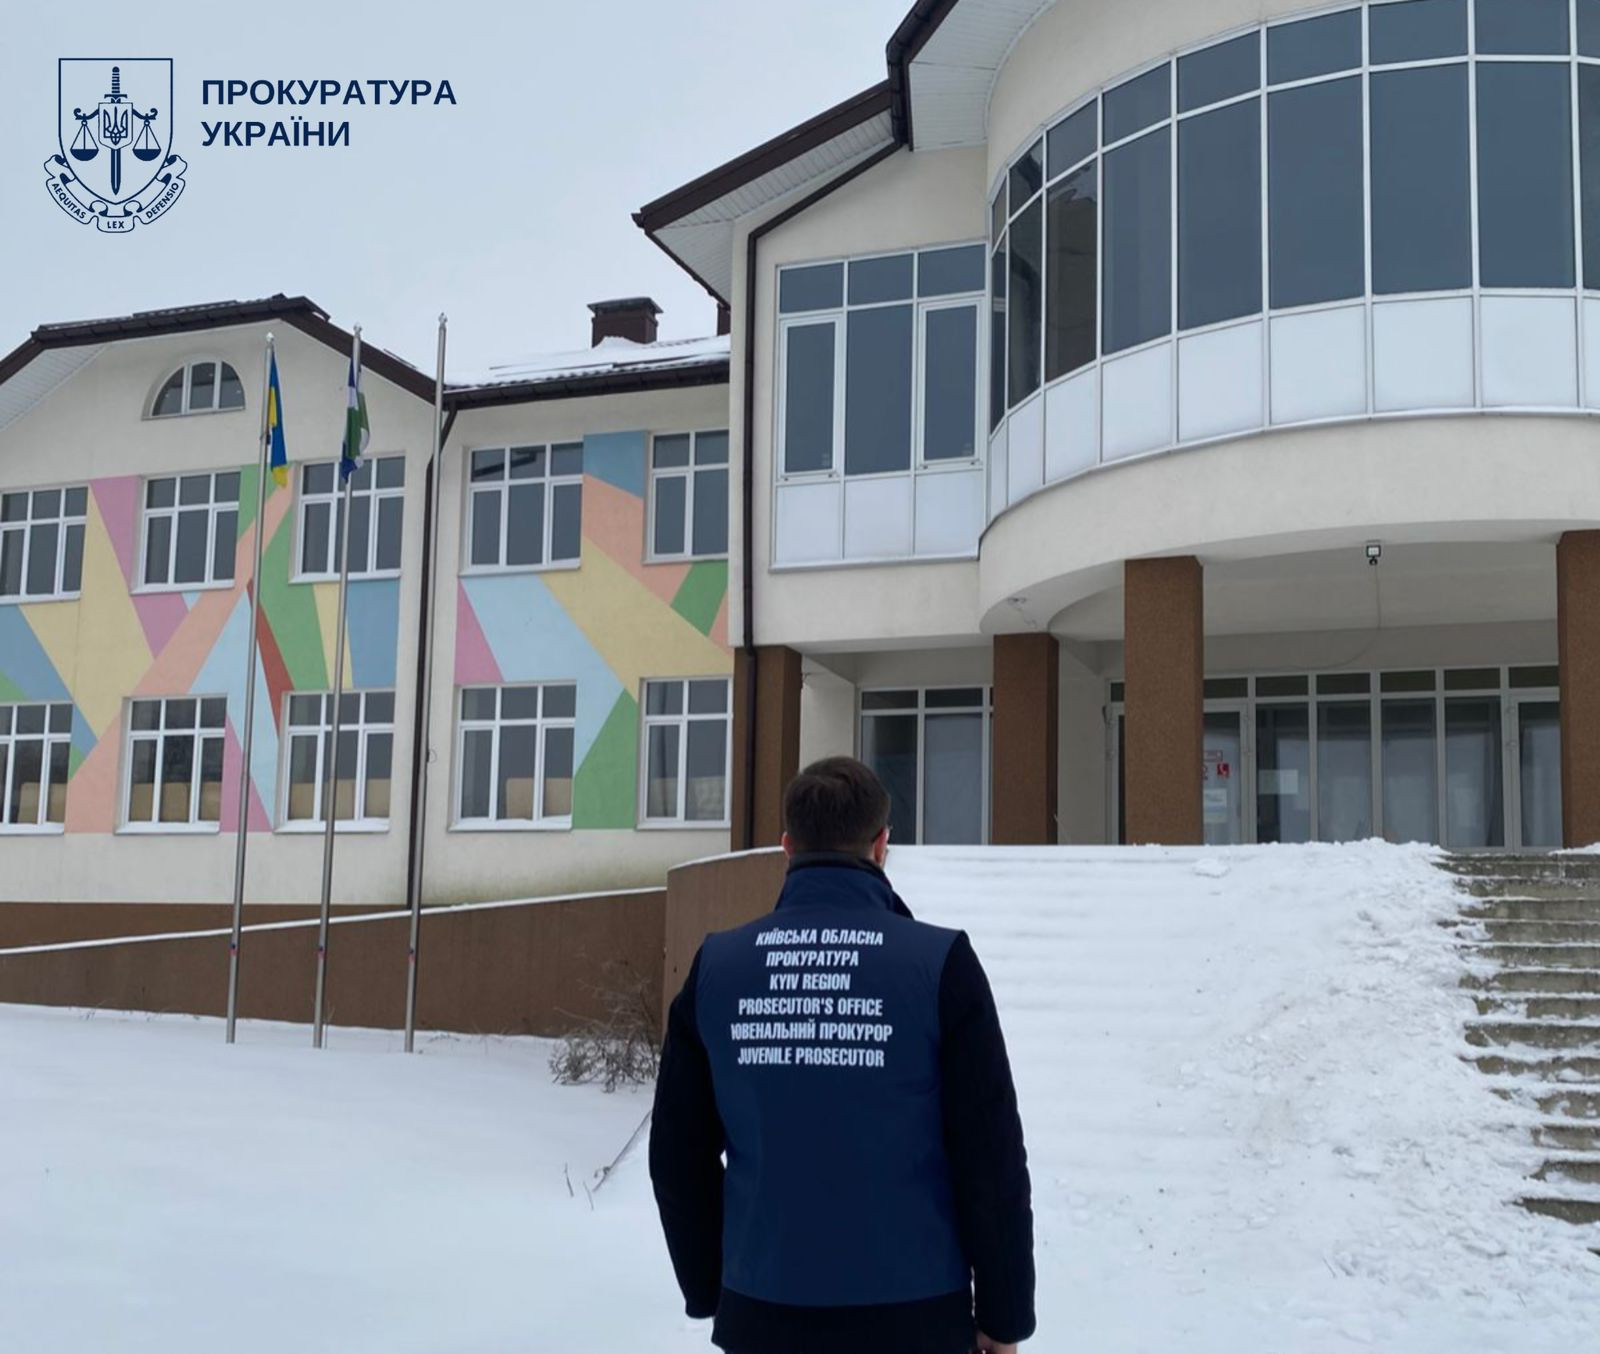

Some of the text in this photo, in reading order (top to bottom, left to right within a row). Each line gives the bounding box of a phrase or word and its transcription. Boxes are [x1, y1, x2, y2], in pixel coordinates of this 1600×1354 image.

[755, 928, 884, 946] КИЇВСЬКА ОБЛАСНА
[765, 950, 859, 967] ПРОКУРАТУРА
[769, 973, 851, 991] KYIV REGION
[738, 998, 883, 1016] PROSECUTOR'S OFFICE
[730, 1018, 893, 1042] ЮВЕНАЛЬНИЙ ПРОКУРОР
[737, 1047, 885, 1068] JUVENILE PROSECUTOR
